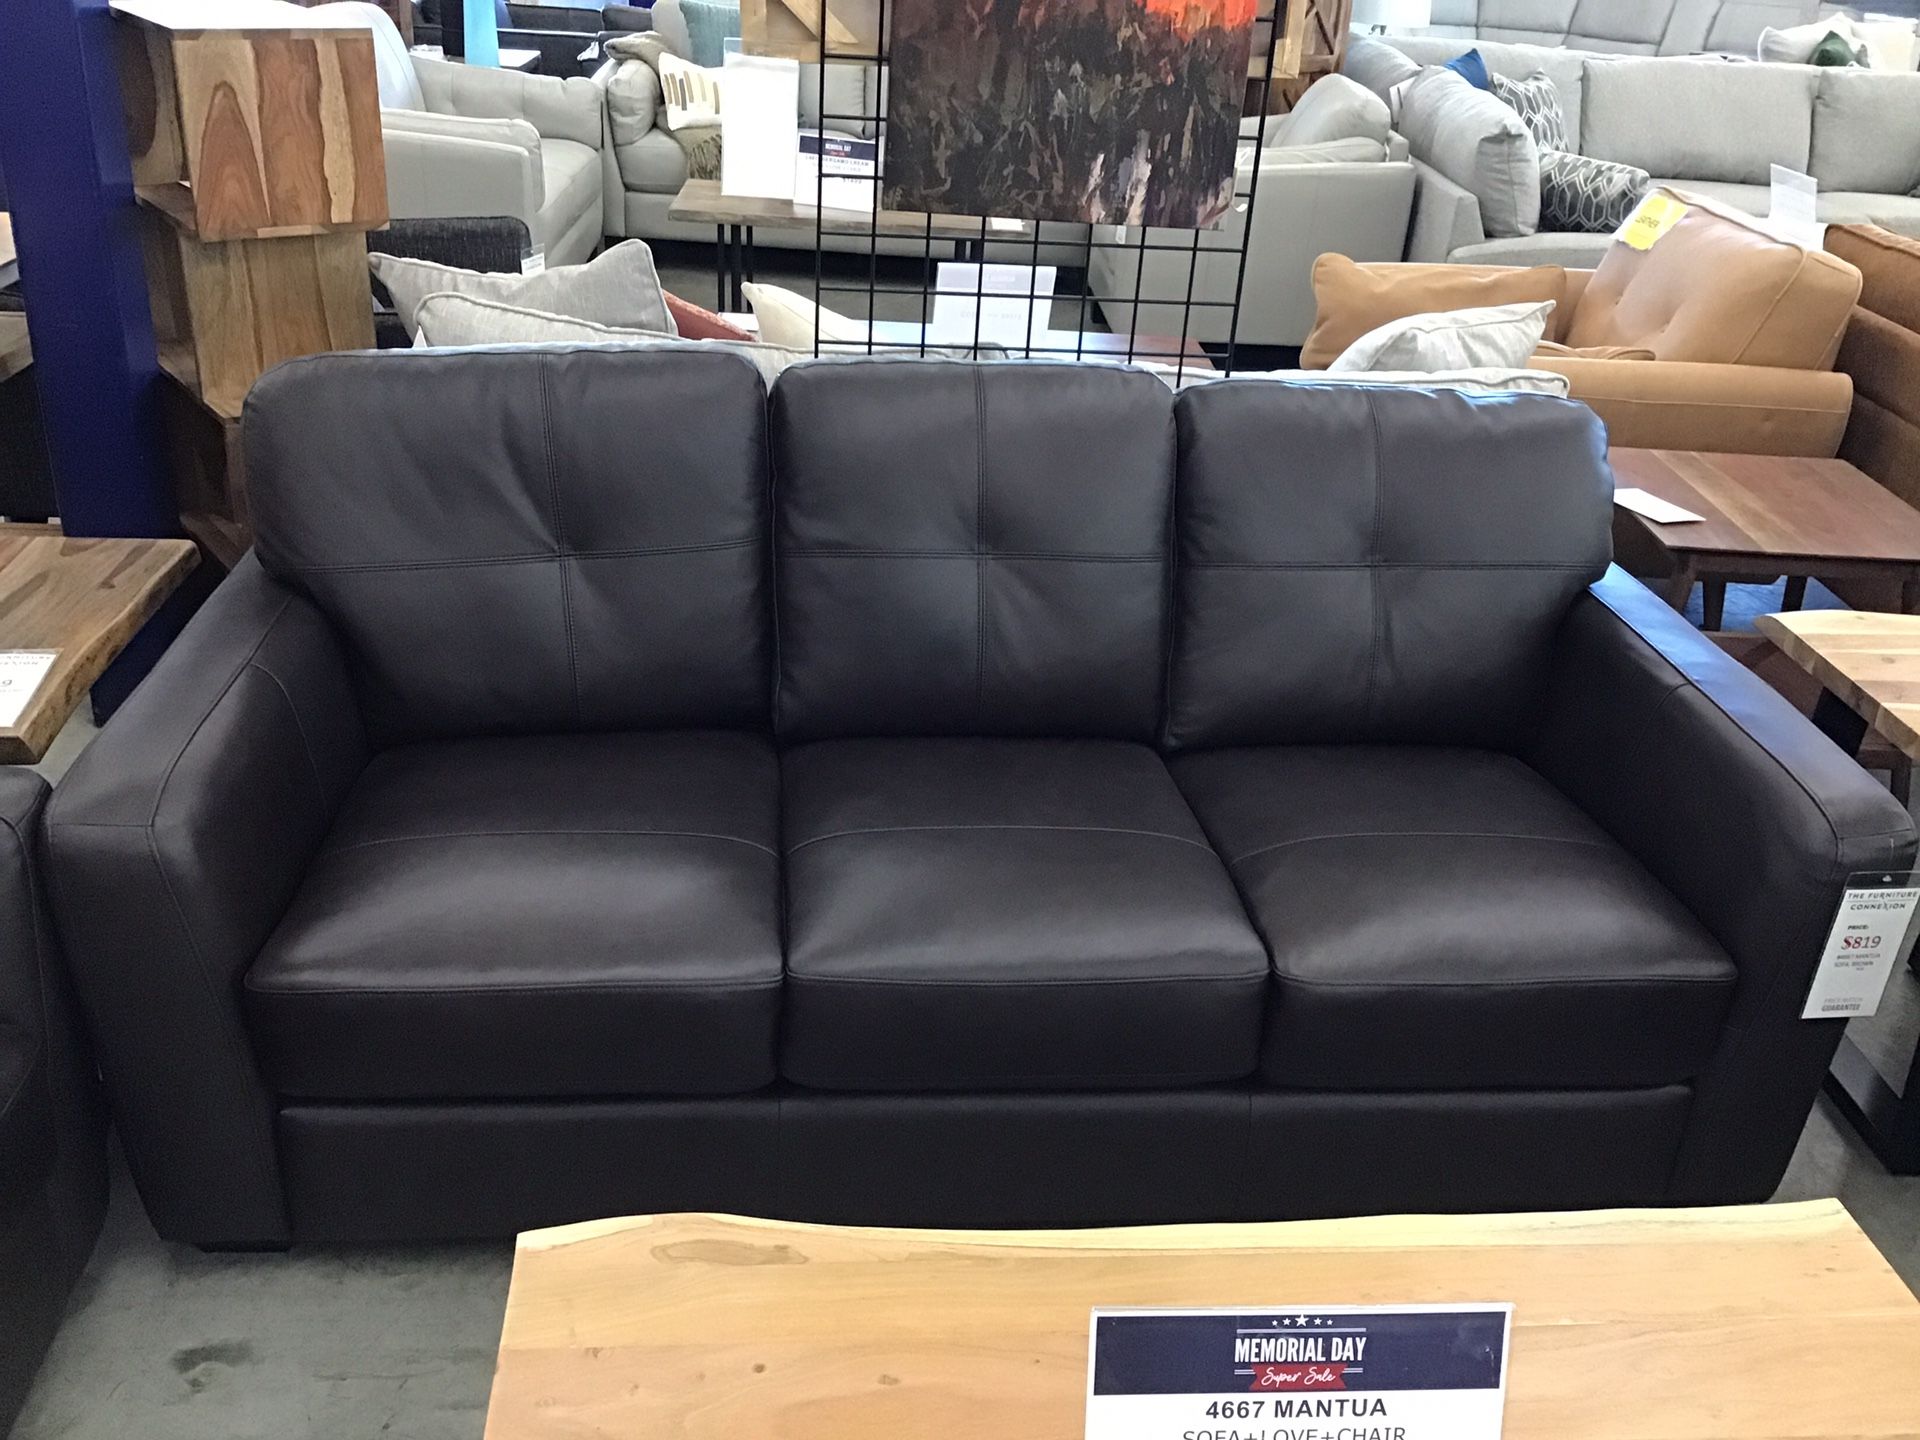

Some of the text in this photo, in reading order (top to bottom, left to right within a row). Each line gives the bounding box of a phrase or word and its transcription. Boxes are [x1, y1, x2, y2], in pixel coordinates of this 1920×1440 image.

[1848, 891, 1918, 900] THE FURNITURE
[1850, 901, 1906, 911] CONNEXION
[1840, 935, 1882, 950] $819
[1821, 1004, 1861, 1012] GUARANTEE
[1234, 1337, 1367, 1362] MEMORIAL DAY
[1261, 1367, 1336, 1388] Super Sale
[1206, 1398, 1388, 1418] 4667 MANTUA
